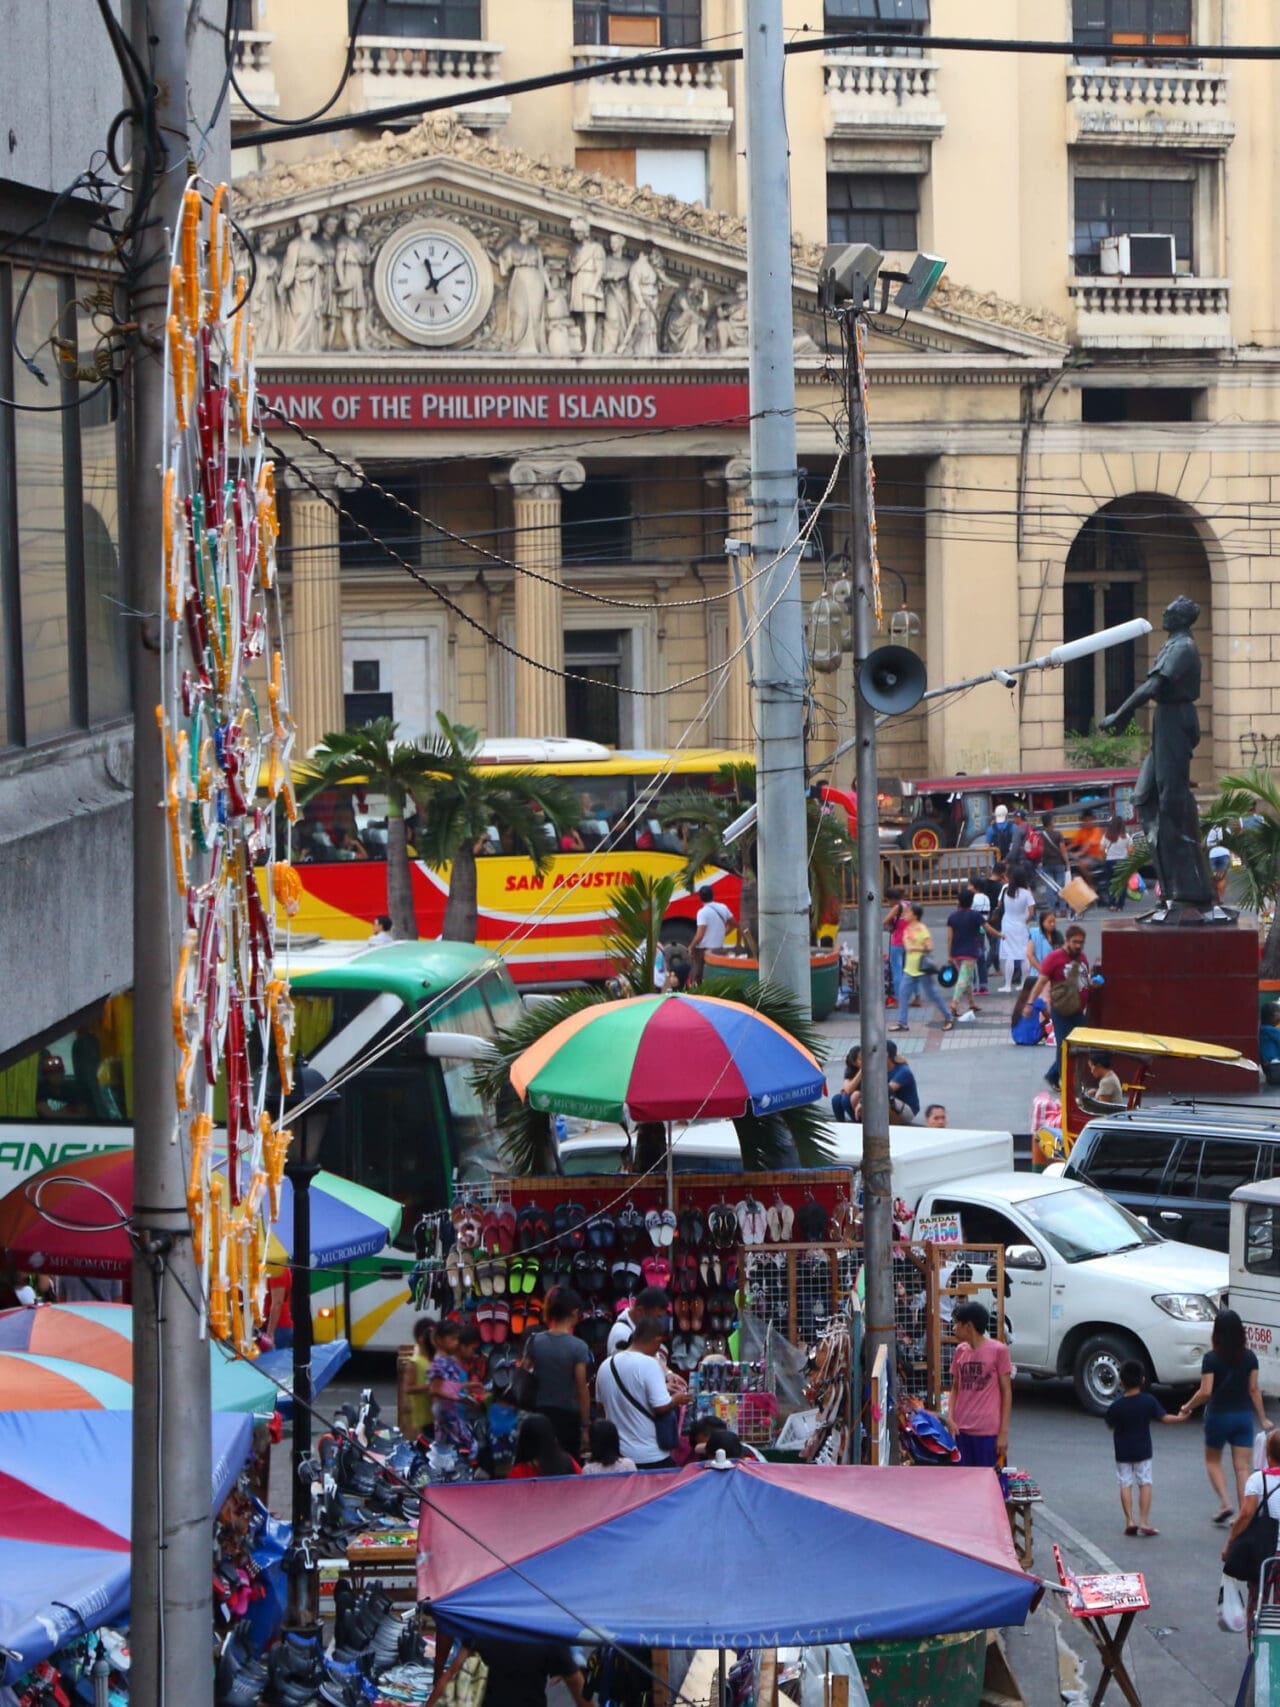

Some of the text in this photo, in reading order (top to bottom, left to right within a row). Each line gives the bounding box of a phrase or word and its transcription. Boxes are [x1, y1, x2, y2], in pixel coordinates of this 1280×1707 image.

[257, 393, 658, 420] BANK OF THE PHILIPPINE ISLANDS
[505, 870, 634, 892] SAN AGUSTIN
[320, 1240, 377, 1262] MICROMATIC
[639, 1623, 872, 1652] MICROMATIC
